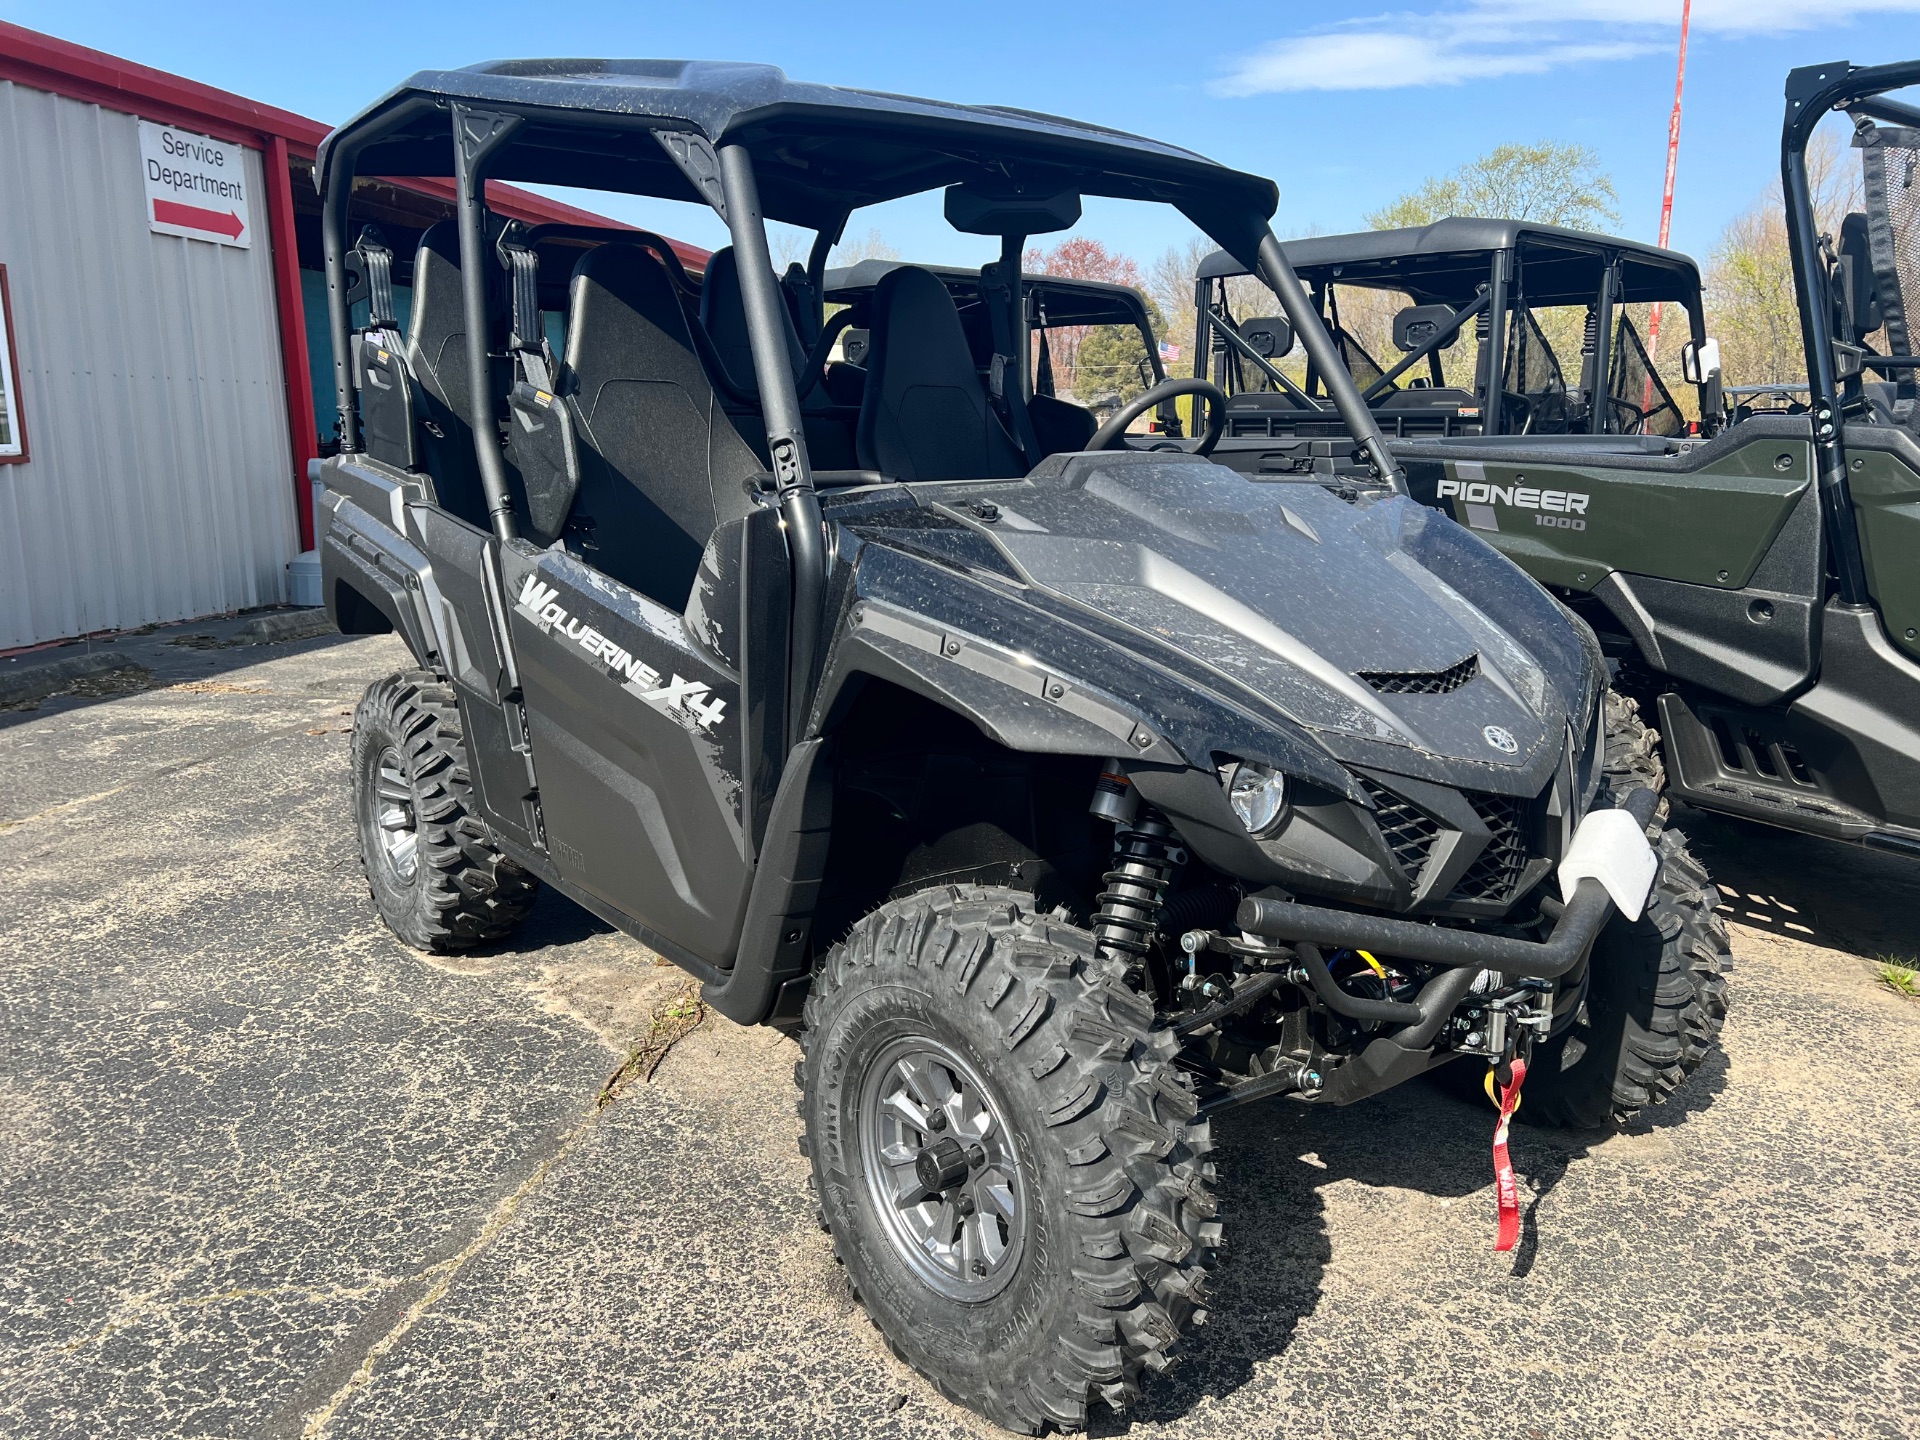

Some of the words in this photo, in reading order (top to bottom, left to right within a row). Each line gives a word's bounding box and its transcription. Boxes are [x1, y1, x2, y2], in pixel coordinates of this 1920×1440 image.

[162, 131, 224, 167] Service
[147, 158, 243, 201] Department
[1436, 479, 1590, 515] PIONEER
[1534, 514, 1586, 531] 1000
[640, 673, 727, 727] X4
[1499, 1165, 1515, 1208] WARN
[999, 1303, 1033, 1354] NHS
